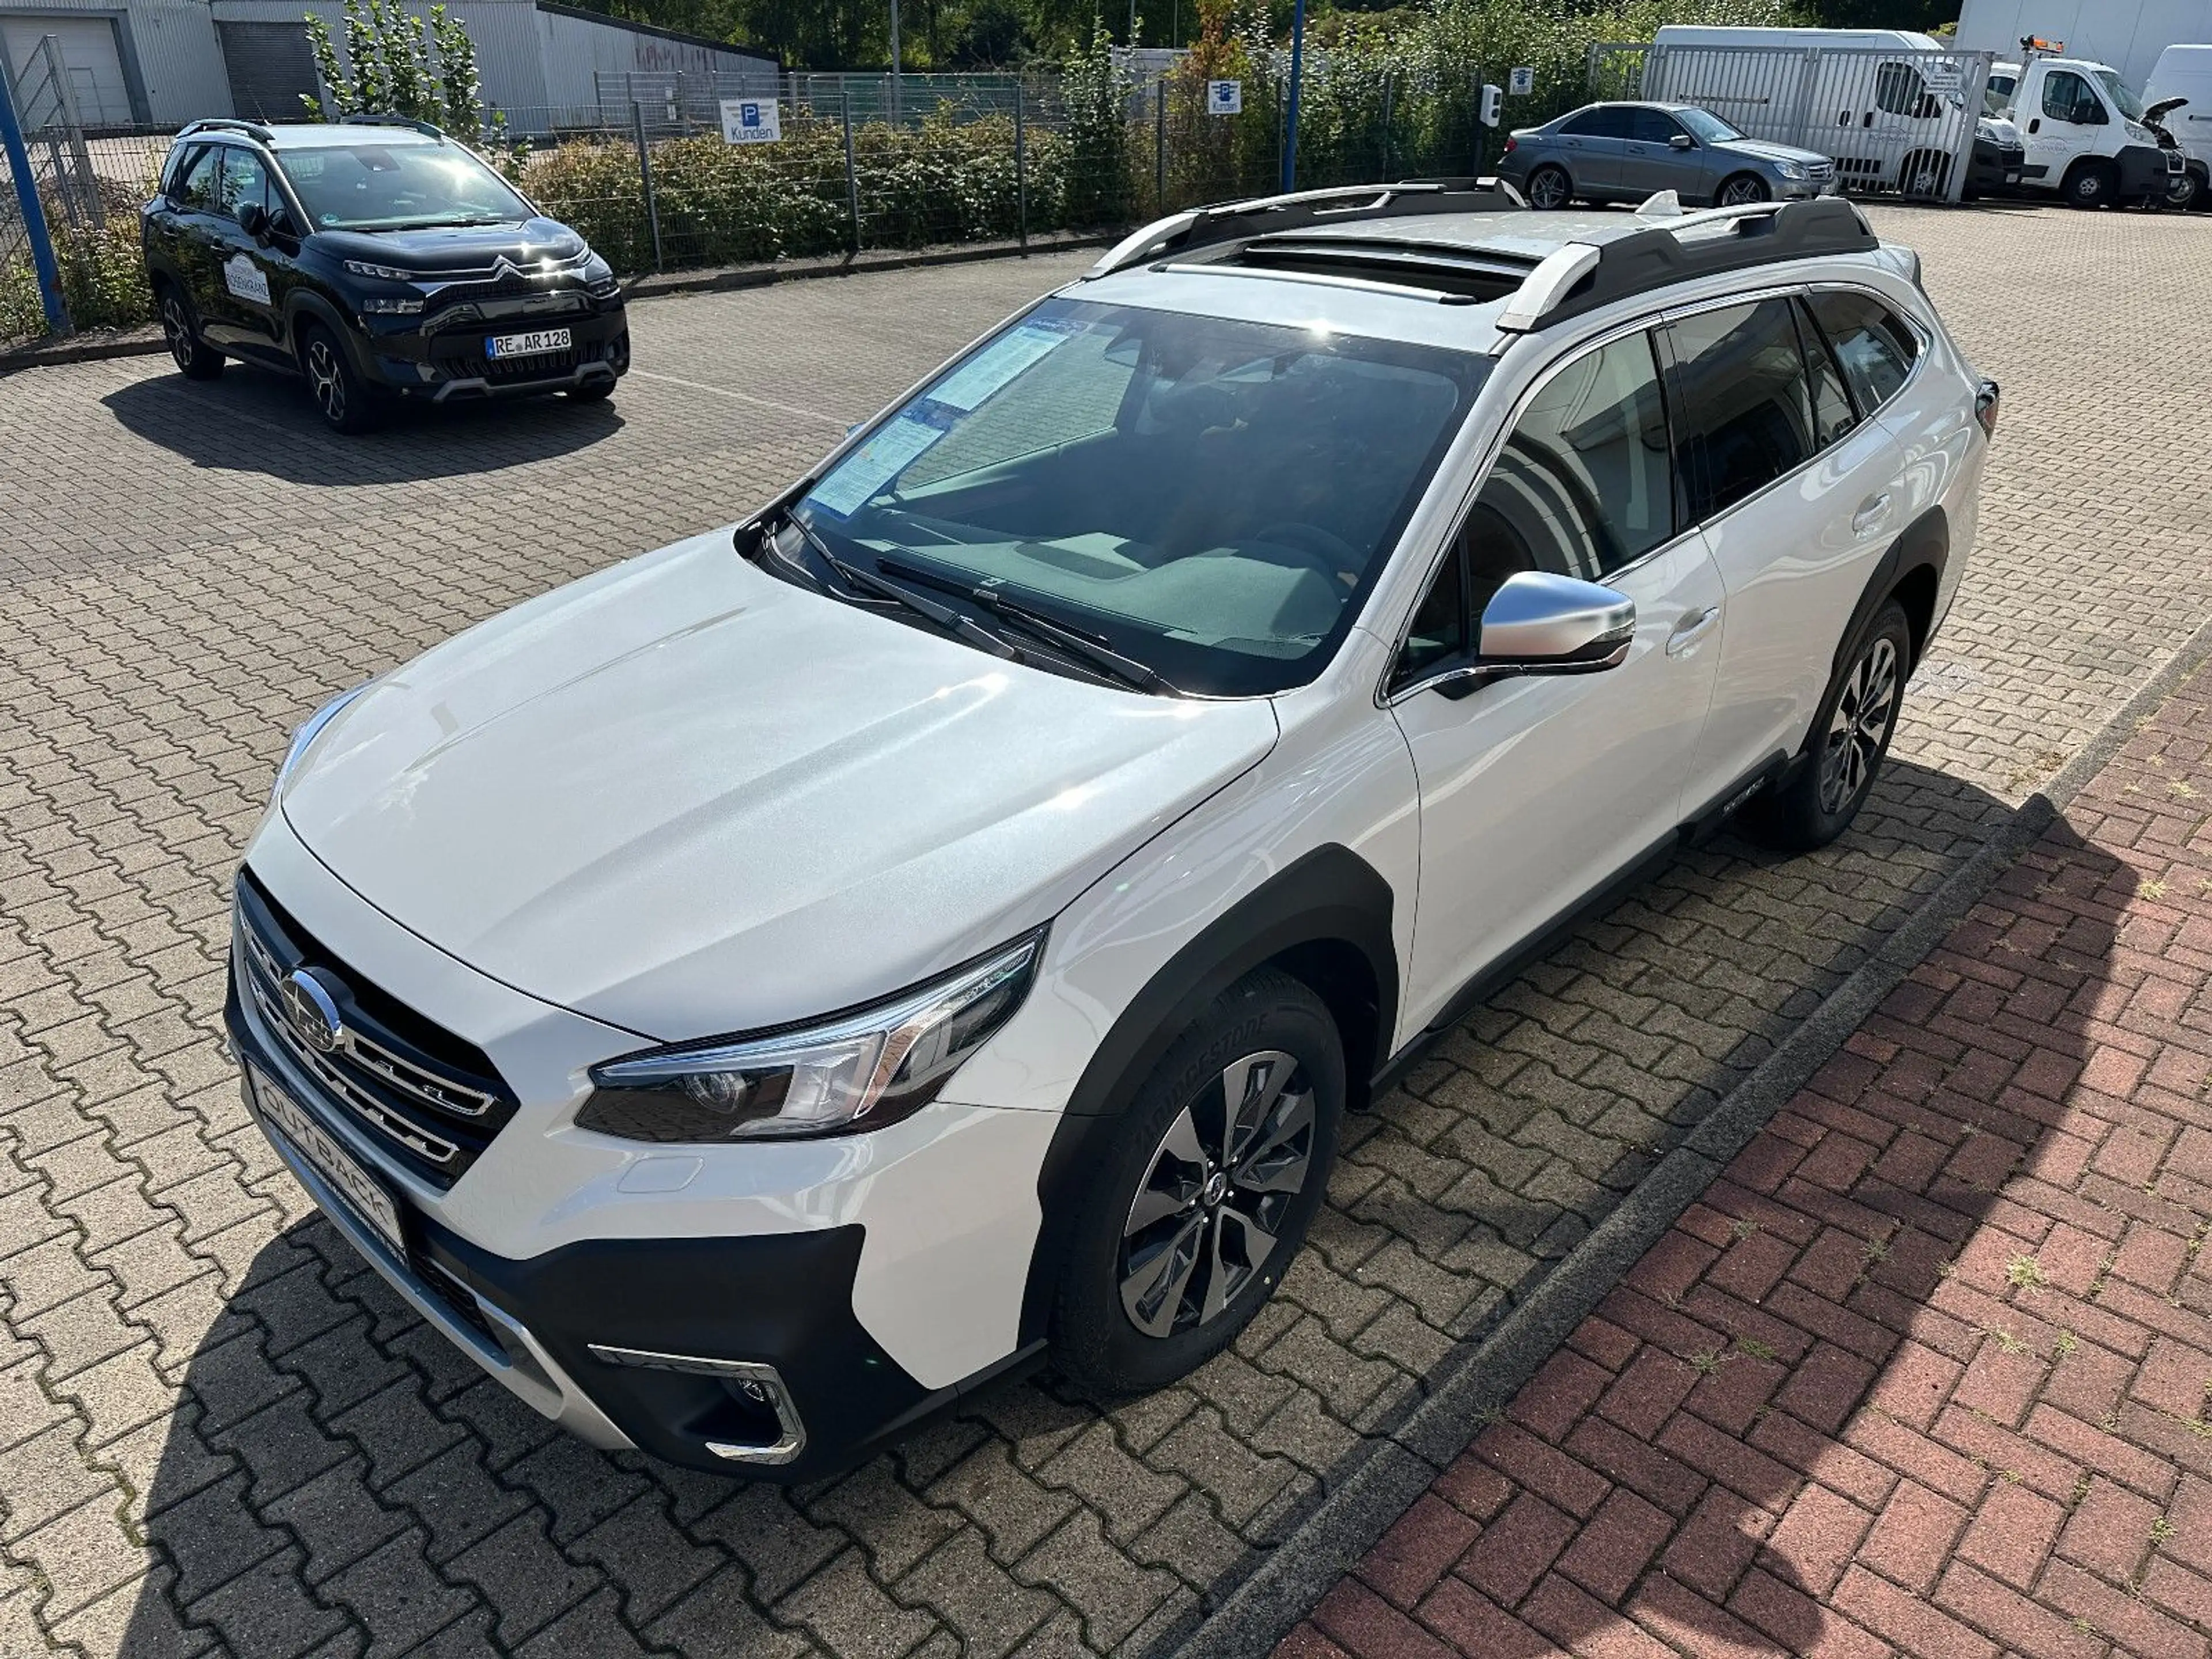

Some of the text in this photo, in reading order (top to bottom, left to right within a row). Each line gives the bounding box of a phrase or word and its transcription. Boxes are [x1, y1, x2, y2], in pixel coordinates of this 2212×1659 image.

[745, 106, 756, 121] P
[731, 126, 773, 140] Kunden
[495, 330, 569, 354] RE AR 128
[262, 1085, 391, 1226] OUTBACK
